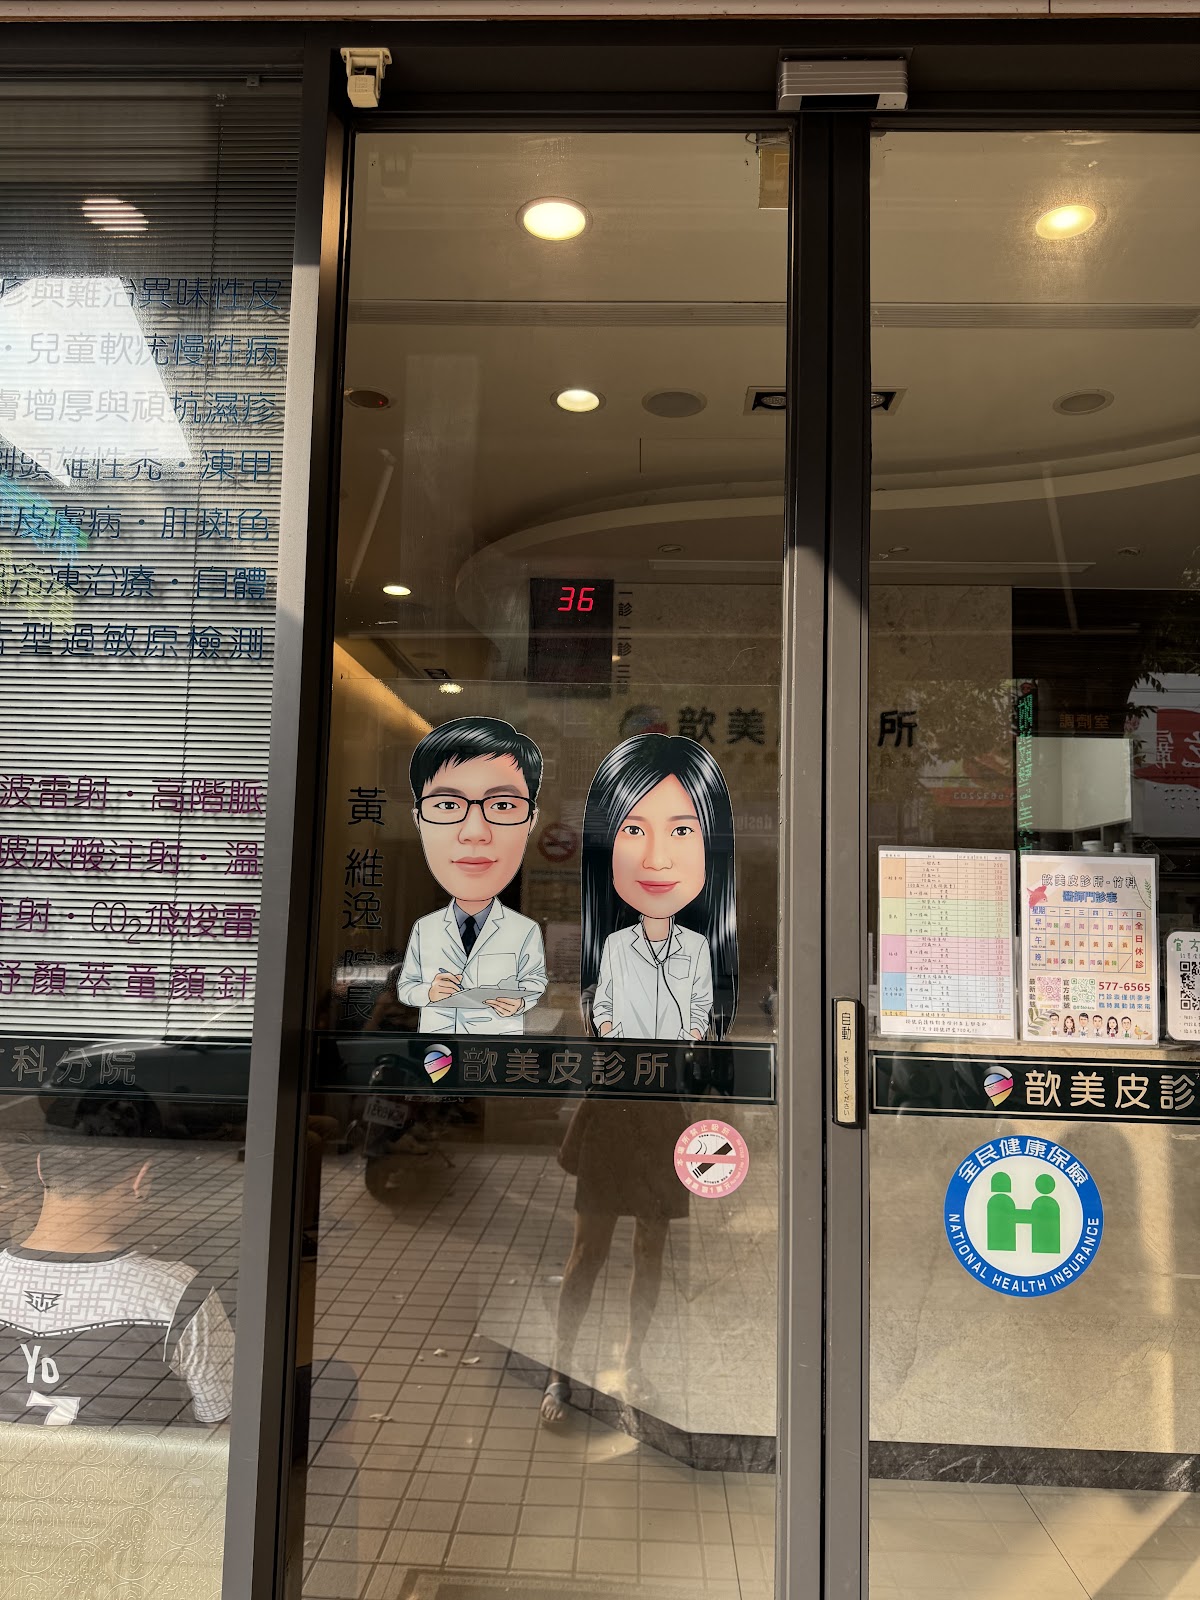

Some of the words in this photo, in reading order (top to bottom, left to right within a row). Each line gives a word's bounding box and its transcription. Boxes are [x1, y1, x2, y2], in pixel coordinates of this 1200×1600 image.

[557, 586, 595, 612] 36
[876, 709, 918, 748] 所
[1135, 921, 1144, 969] 全日休診
[1098, 981, 1151, 991] 577-6565
[841, 1012, 852, 1041] 自動
[0, 1044, 136, 1087] 科分院
[462, 1048, 671, 1089] 歆美皮診所
[1024, 1069, 1196, 1112] 歆美皮診
[958, 1136, 1089, 1188] 全民健康保險
[948, 1213, 987, 1279] NATIONAL
[991, 1273, 1048, 1293] HEALTH
[1050, 1217, 1100, 1287] INSURANCE
[20, 1343, 60, 1384] Yo
